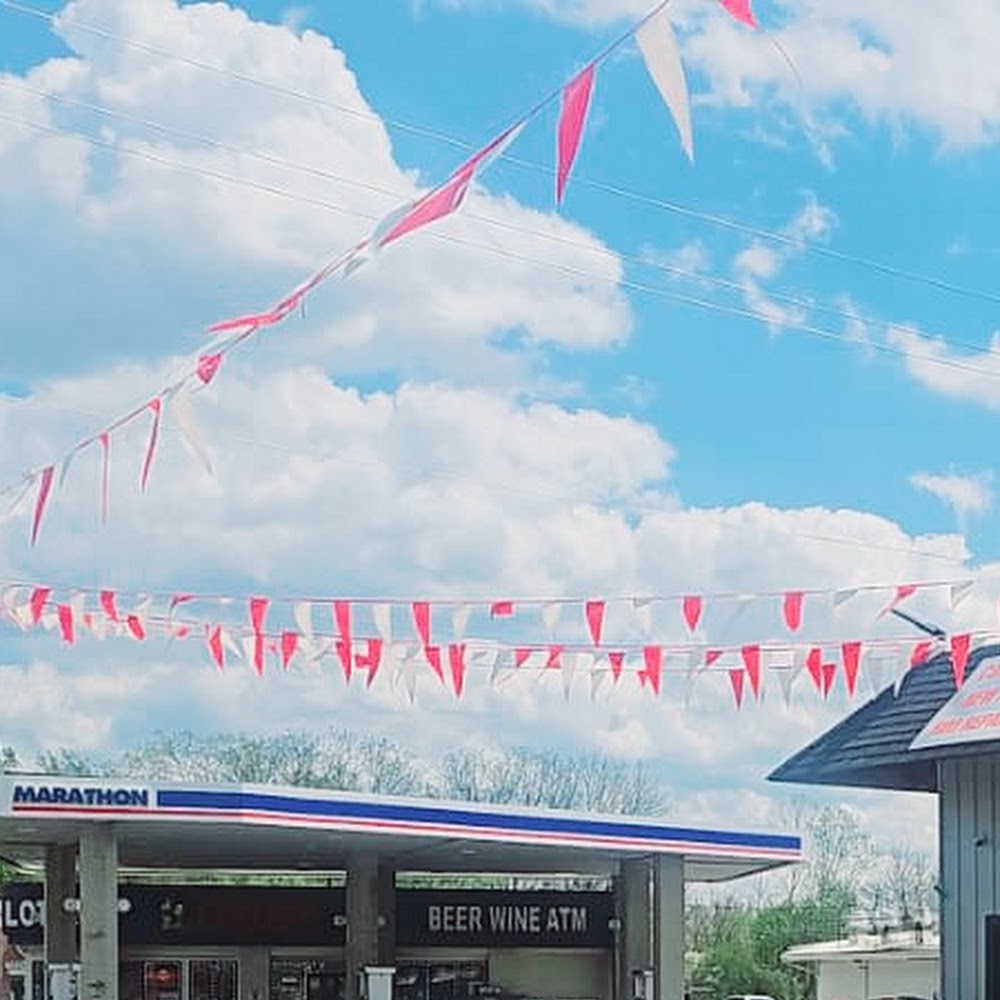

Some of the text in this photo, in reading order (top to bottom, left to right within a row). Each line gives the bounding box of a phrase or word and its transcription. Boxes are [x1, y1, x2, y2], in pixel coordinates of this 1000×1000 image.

[13, 786, 148, 806] MARATHON
[428, 905, 587, 932] BEER WINE ATM
